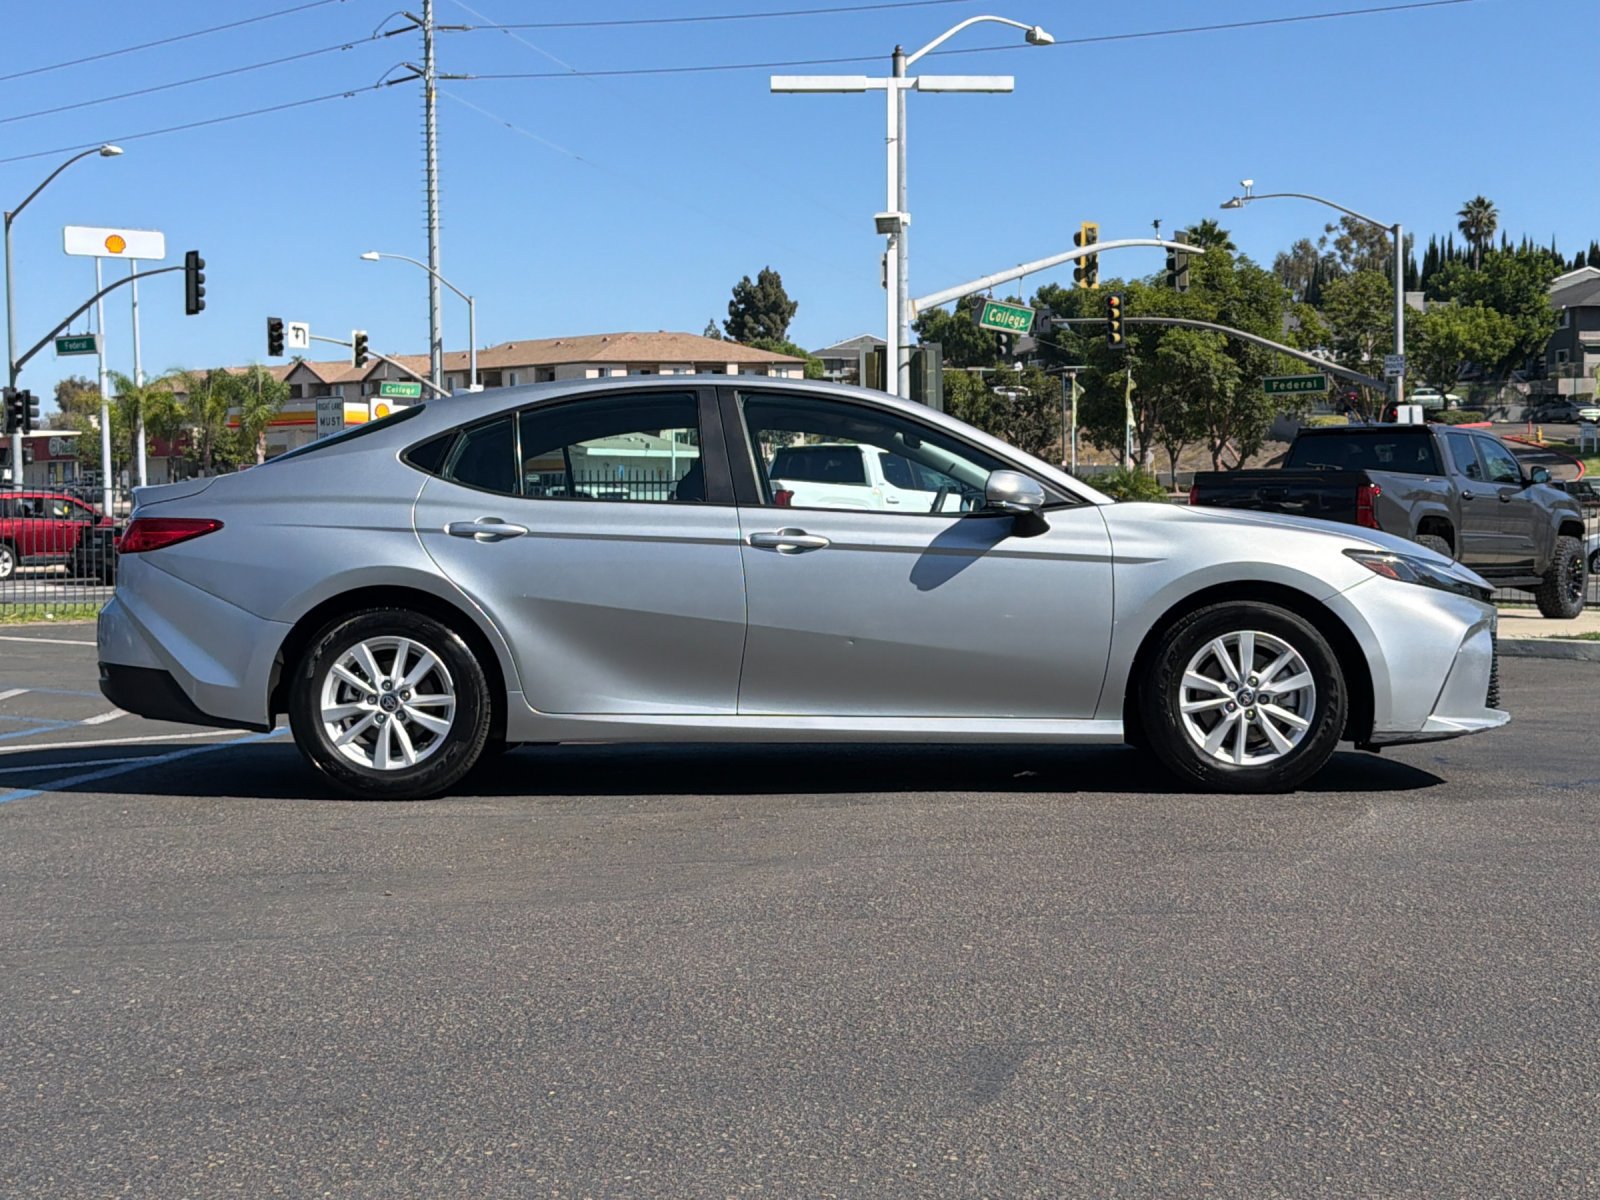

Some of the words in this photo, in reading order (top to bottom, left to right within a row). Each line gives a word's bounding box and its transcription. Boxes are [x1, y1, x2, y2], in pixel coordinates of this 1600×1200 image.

[989, 308, 1026, 329] College
[63, 341, 88, 350] Federal
[385, 385, 416, 395] College
[1272, 380, 1317, 391] Federal
[320, 416, 341, 427] MUST
